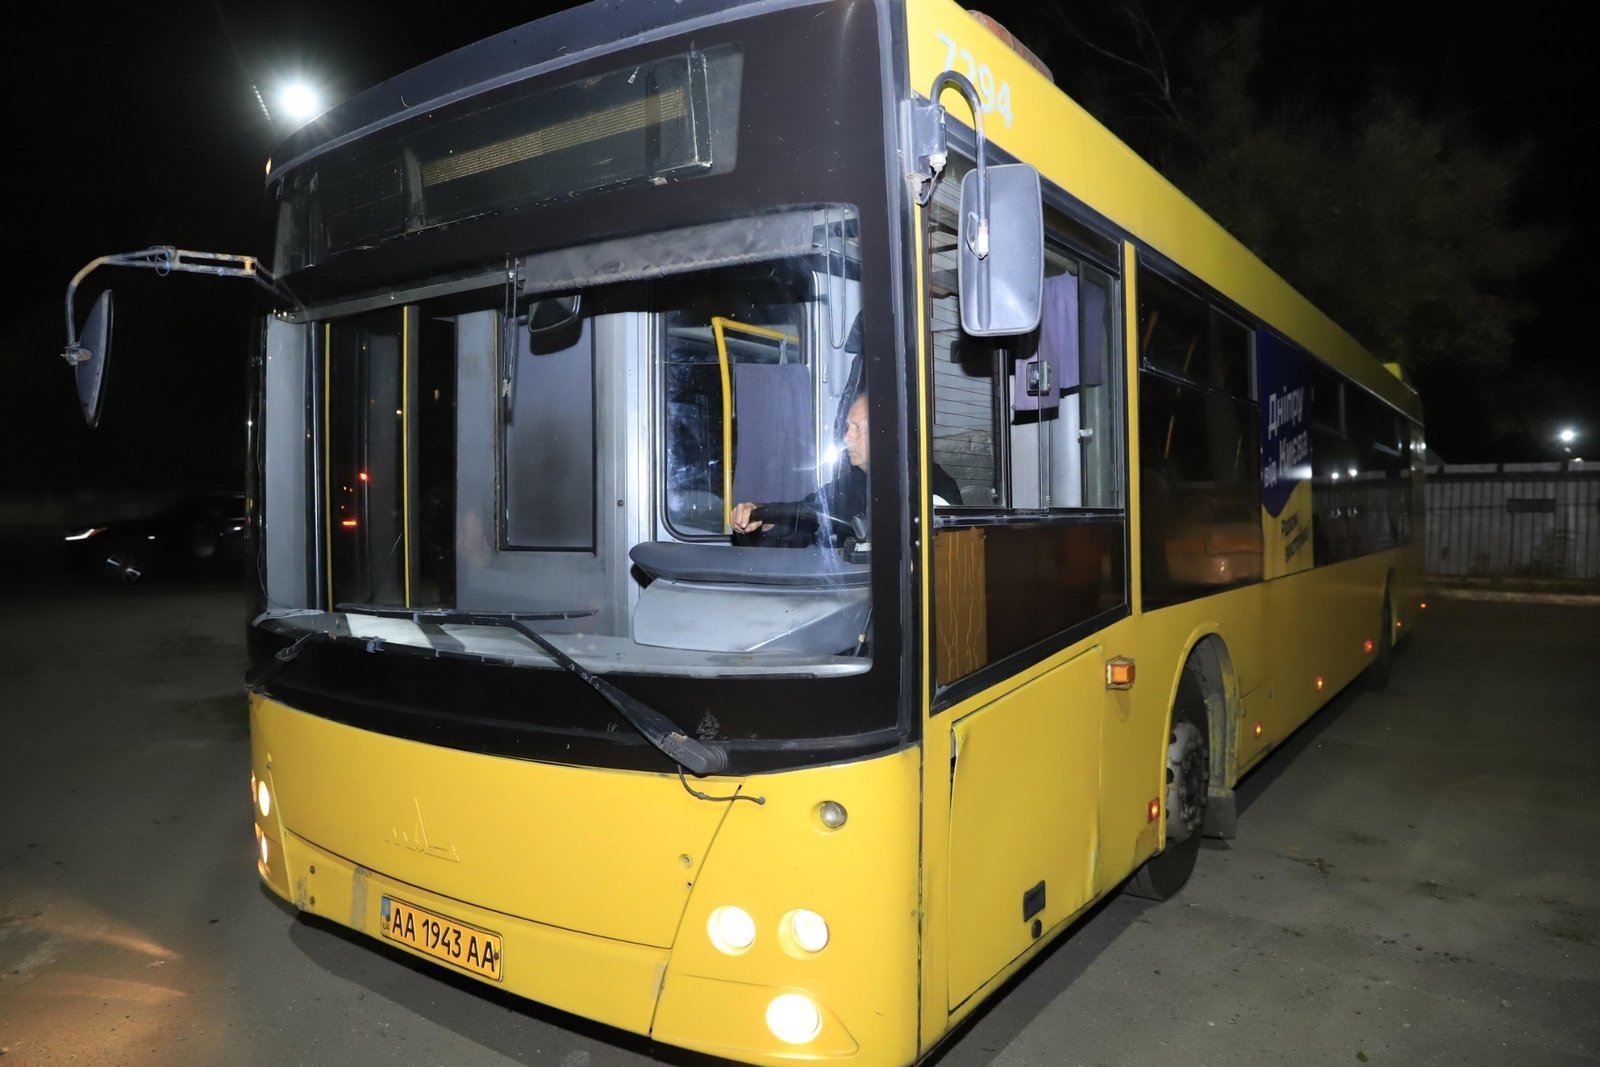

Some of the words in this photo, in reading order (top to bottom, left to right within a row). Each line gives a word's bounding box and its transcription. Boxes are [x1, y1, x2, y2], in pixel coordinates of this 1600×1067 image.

[1268, 386, 1304, 440] Дніпру
[392, 907, 416, 942] AA
[422, 918, 462, 958] 1943
[467, 935, 495, 972] AA
